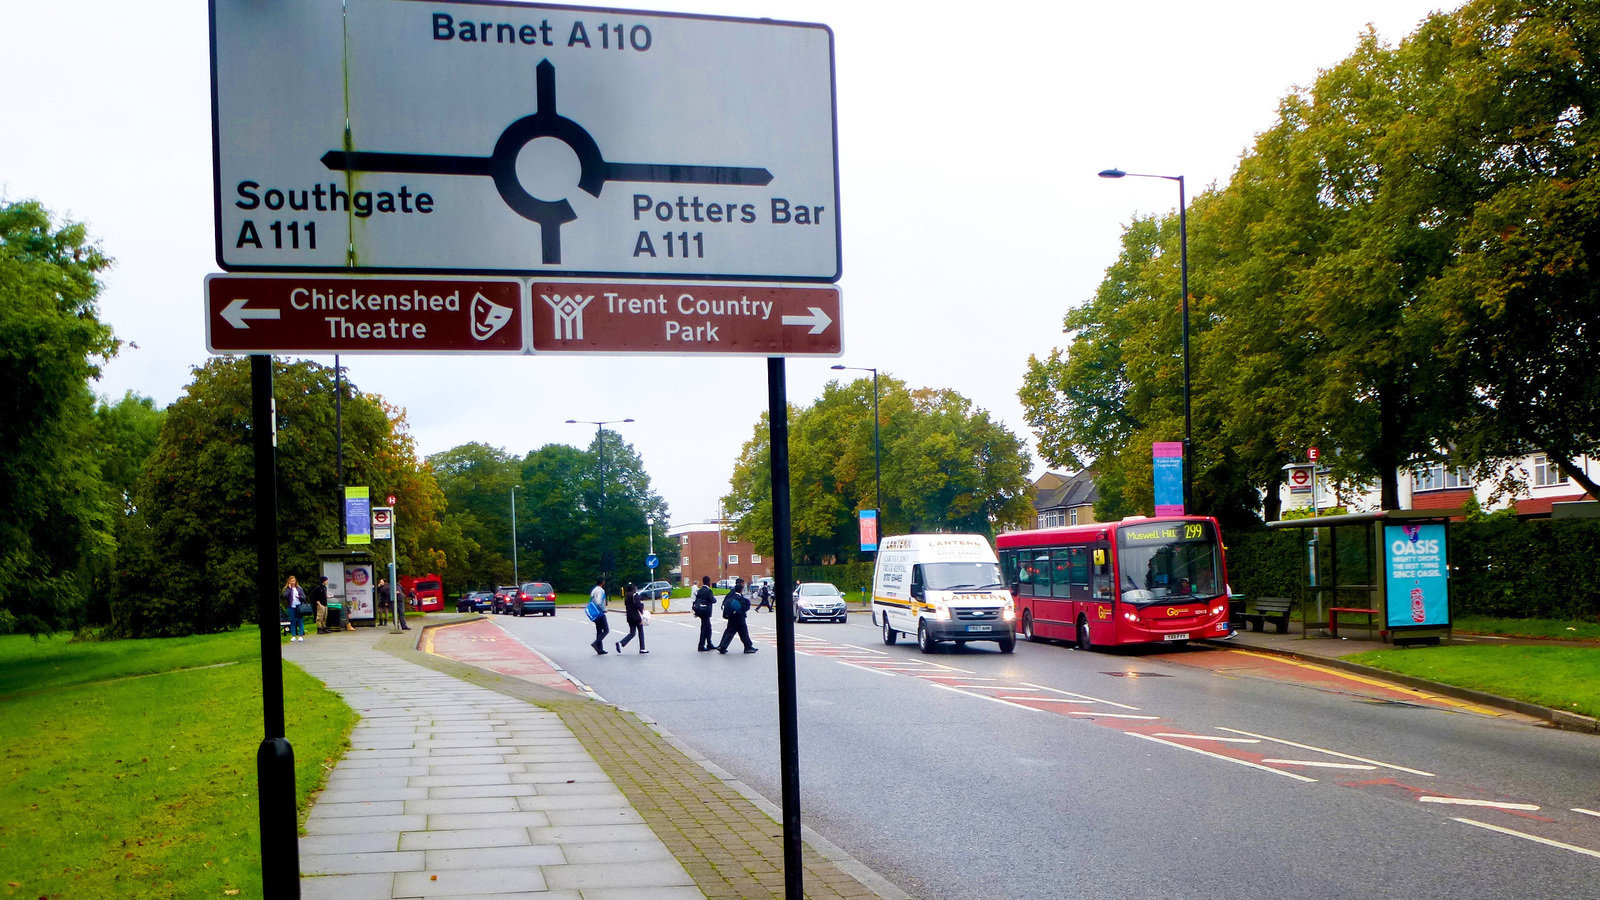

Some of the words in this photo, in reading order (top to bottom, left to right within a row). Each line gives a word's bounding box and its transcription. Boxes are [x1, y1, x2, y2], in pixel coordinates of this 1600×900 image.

[433, 14, 553, 47] Barnet
[568, 18, 651, 51] A110
[236, 179, 435, 217] Southgate
[633, 194, 756, 225] Potters
[770, 197, 825, 226] Bar
[236, 220, 318, 250] A111
[633, 230, 704, 259] A111
[290, 288, 460, 312] Chickenshed
[603, 292, 668, 315] Trent
[676, 293, 774, 322] Country
[324, 316, 427, 340] Theatre
[665, 319, 720, 343] Park
[1309, 449, 1317, 459] E
[1127, 529, 1160, 541] Muswell
[1162, 529, 1176, 539] Hill
[1184, 524, 1202, 539] 299
[1392, 539, 1439, 555] OASIS
[1393, 570, 1416, 578] SINCE
[942, 593, 1007, 602] LANTERN
